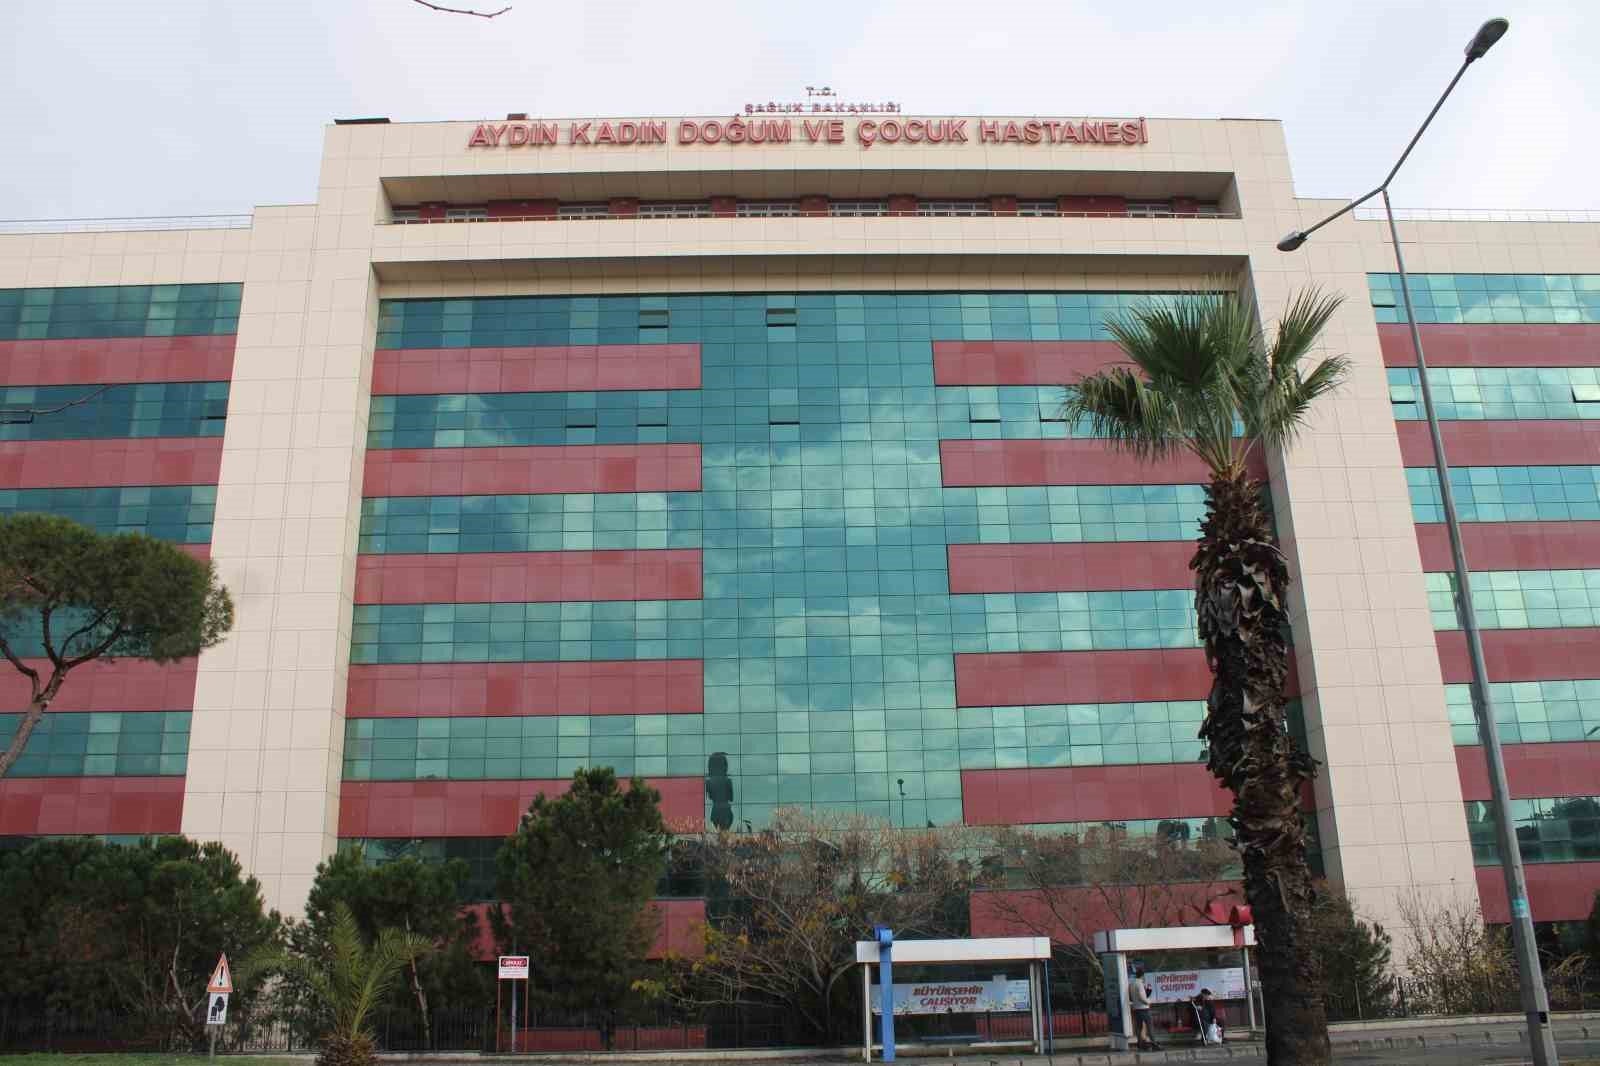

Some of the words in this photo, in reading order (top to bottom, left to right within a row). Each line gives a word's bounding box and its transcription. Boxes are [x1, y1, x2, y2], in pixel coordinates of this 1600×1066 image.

[467, 122, 560, 147] AYDIN
[570, 120, 667, 146] KADIN
[678, 113, 793, 145] DOĞUM
[804, 119, 845, 144] VE
[858, 119, 969, 150] ÇOCUK
[979, 116, 1149, 146] HASTANESİ
